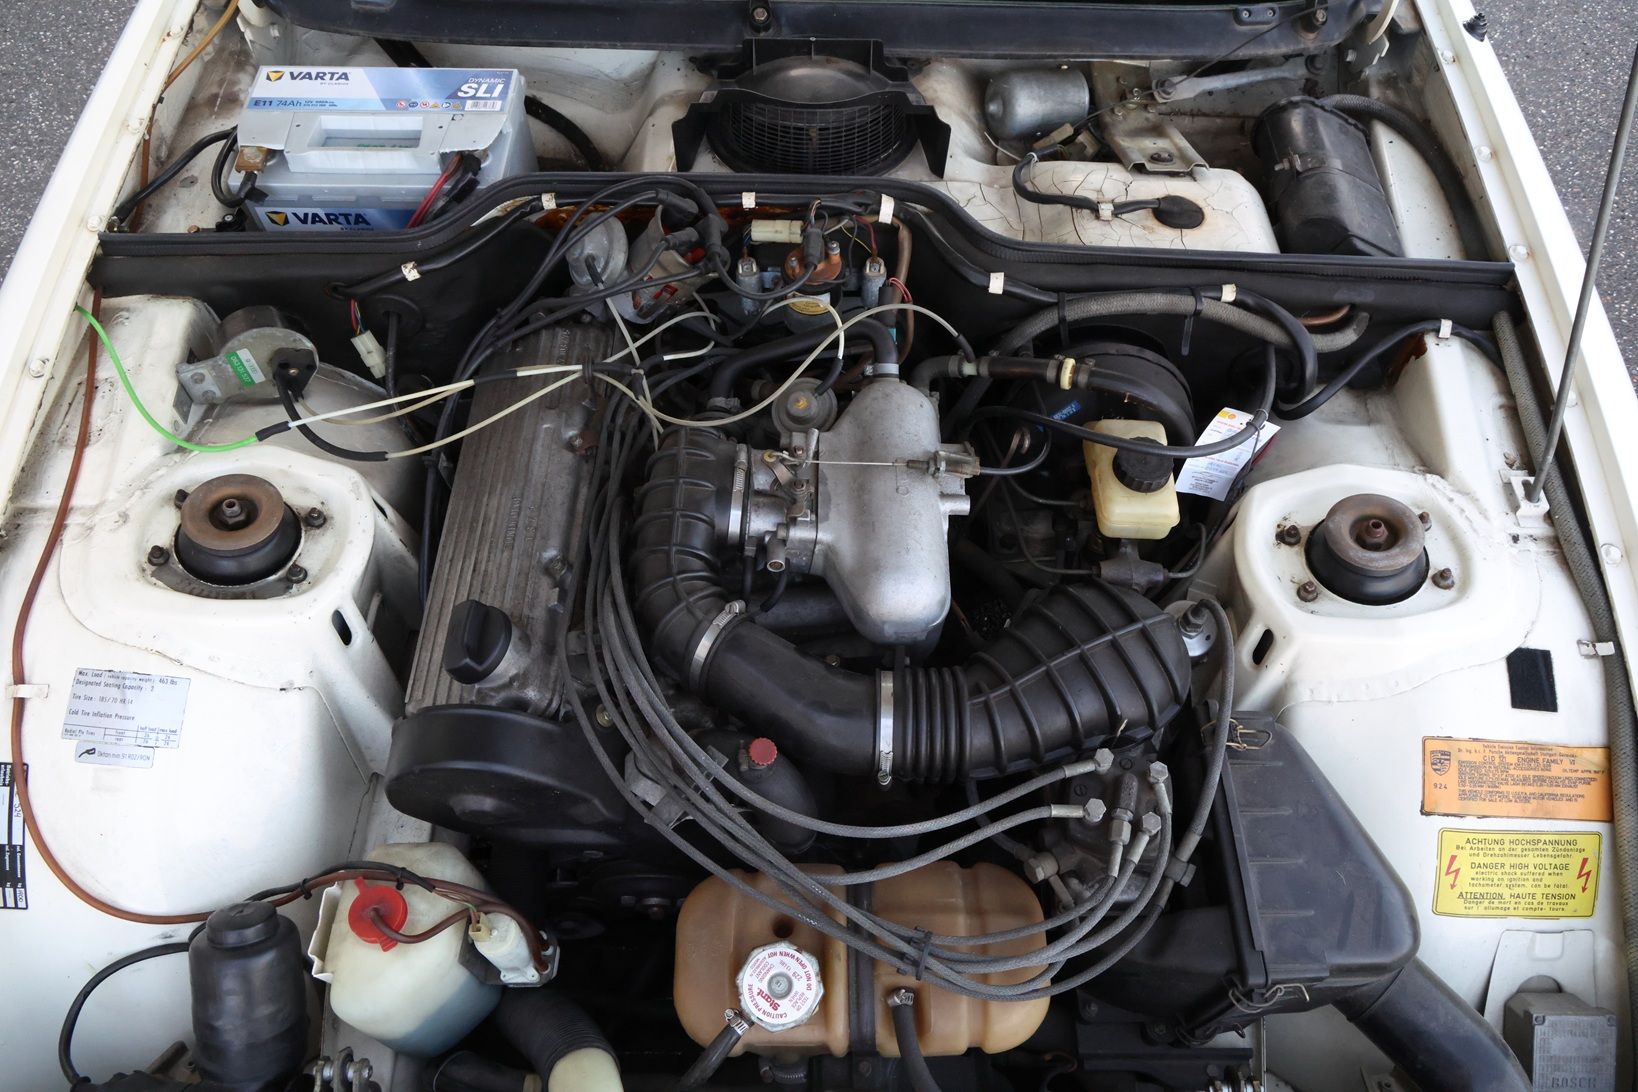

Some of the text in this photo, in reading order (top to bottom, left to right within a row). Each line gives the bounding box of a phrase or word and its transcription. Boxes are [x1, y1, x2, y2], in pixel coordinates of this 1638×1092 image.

[289, 72, 350, 81] VARTA
[457, 83, 504, 97] SLI
[291, 212, 371, 226] VARTA
[778, 951, 795, 959] WHEN
[794, 956, 807, 970] OPEN
[804, 968, 812, 982] NOT
[806, 982, 812, 991] DO
[748, 984, 787, 1019] CAUTION PRESSURE
[757, 988, 780, 1011] Stant
